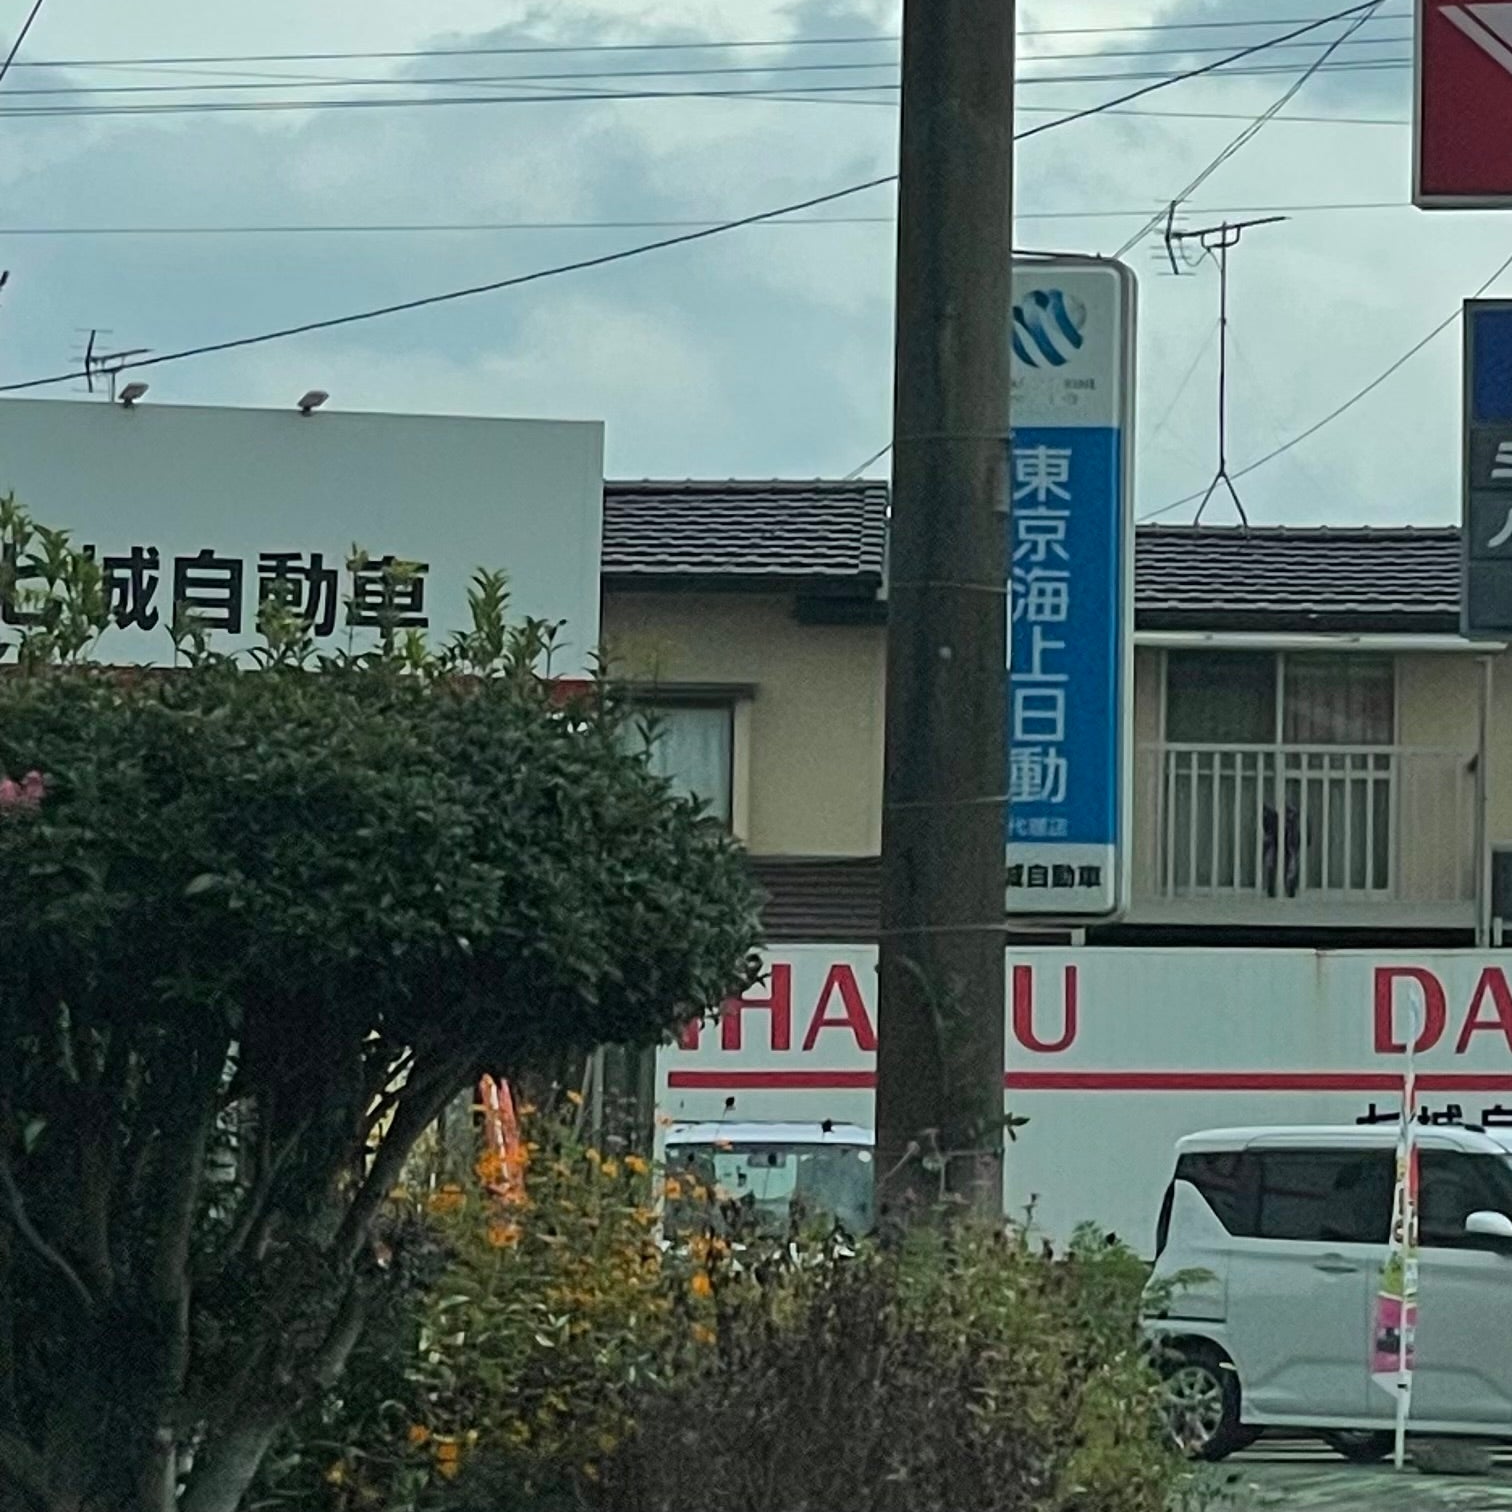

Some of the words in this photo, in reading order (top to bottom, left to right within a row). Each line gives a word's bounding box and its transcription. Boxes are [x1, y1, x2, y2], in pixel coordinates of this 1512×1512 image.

[1009, 445, 1073, 803] 東京海上日動
